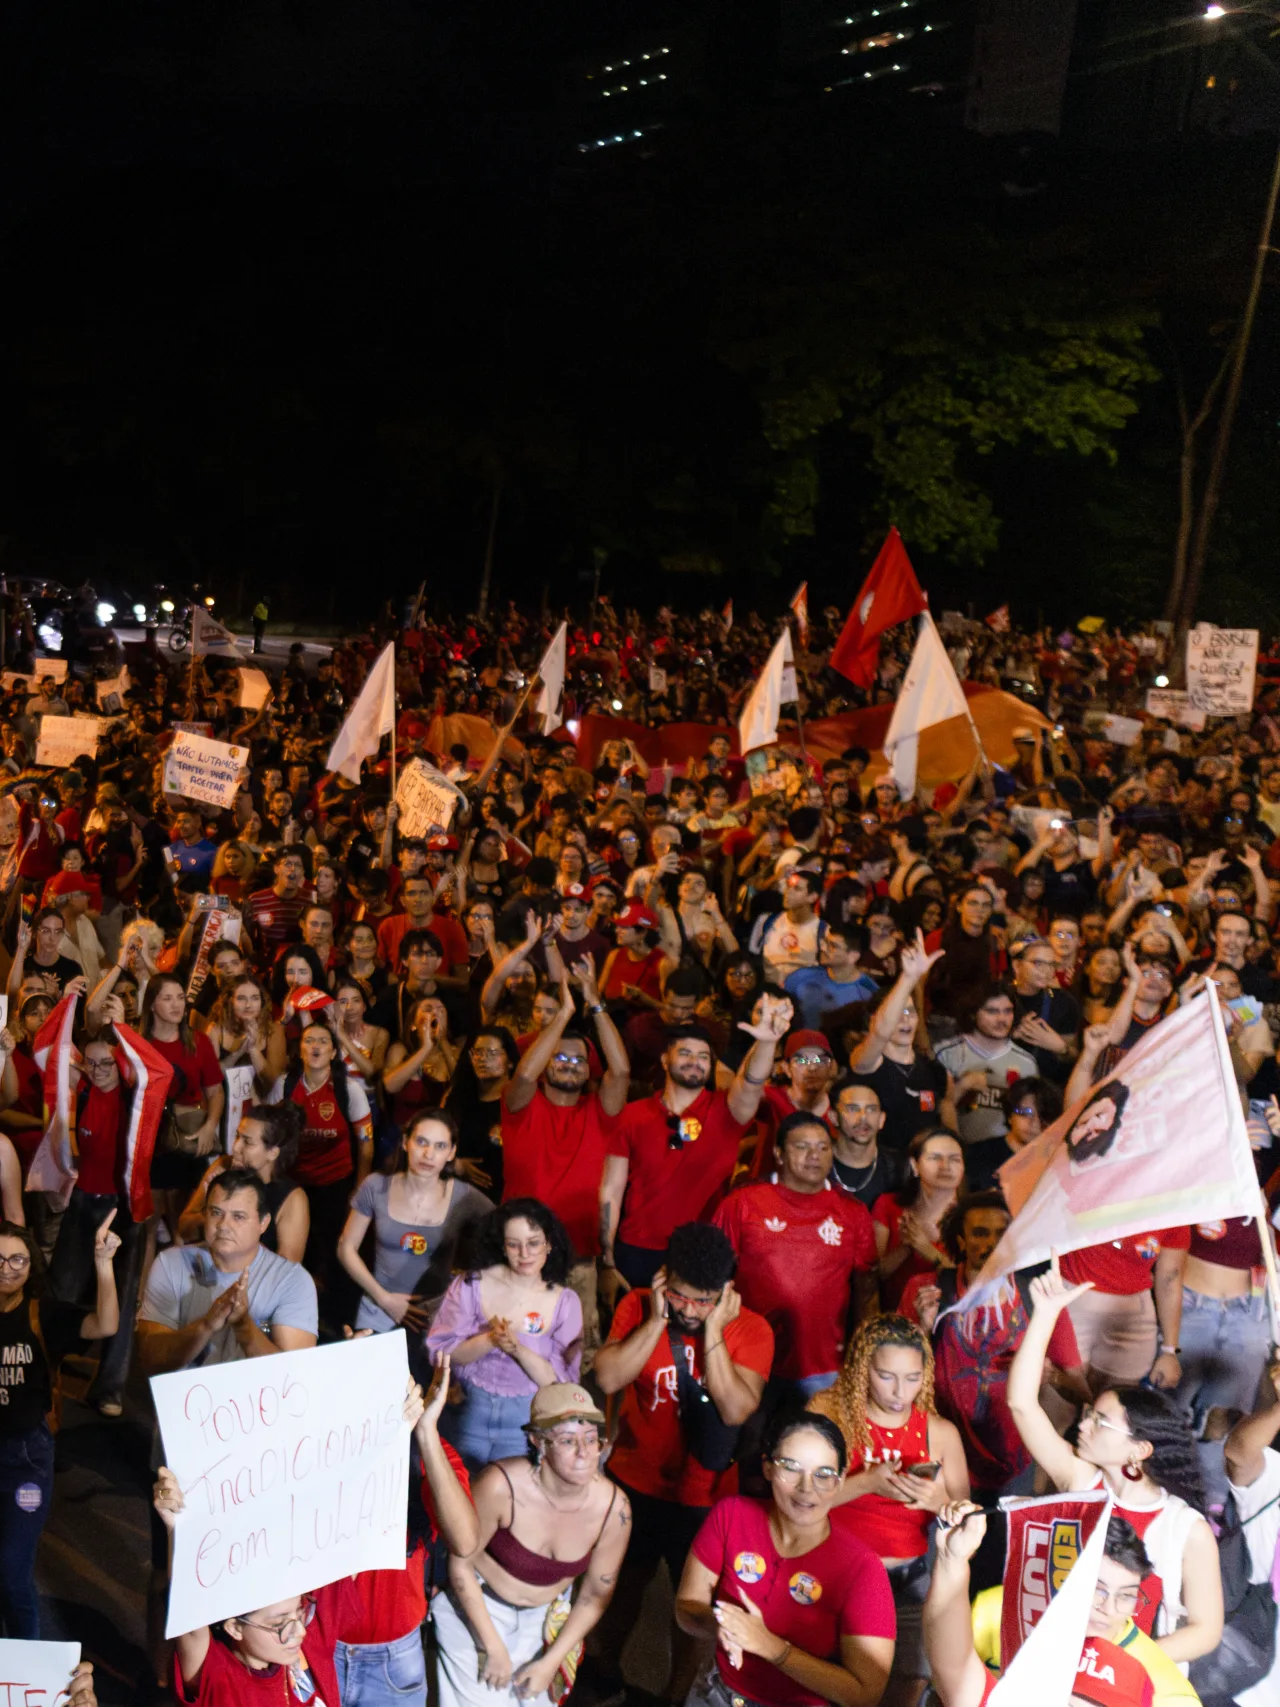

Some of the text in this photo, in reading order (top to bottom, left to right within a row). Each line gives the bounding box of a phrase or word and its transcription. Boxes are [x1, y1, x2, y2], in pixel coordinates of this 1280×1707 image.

[176, 745, 239, 772] NÃO LUTAMOS
[177, 761, 205, 776] TANTO
[189, 775, 226, 793] ACEITAR
[2, 1343, 33, 1366] MÃO
[1074, 1658, 1115, 1686] ULA
